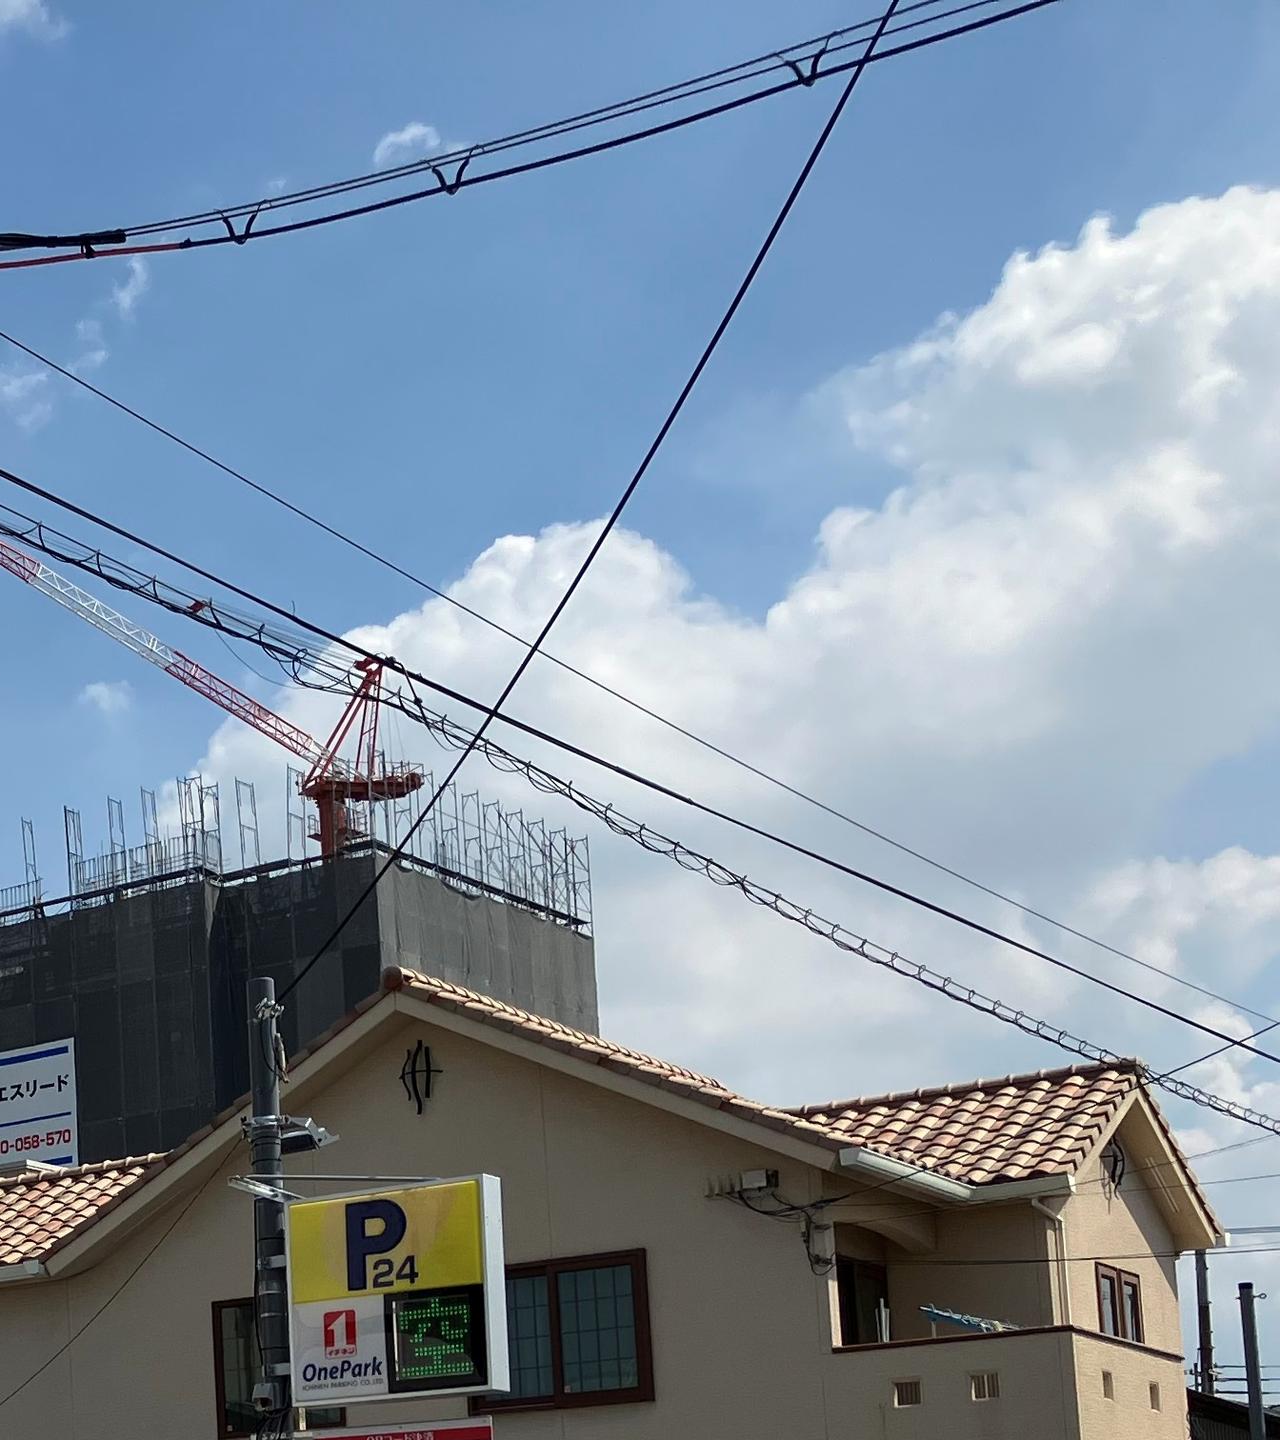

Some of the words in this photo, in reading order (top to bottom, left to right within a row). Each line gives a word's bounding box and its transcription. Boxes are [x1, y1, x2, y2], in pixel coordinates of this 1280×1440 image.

[345, 1199, 407, 1291] P
[372, 1255, 419, 1288] 24
[303, 1356, 383, 1383] OnePark
